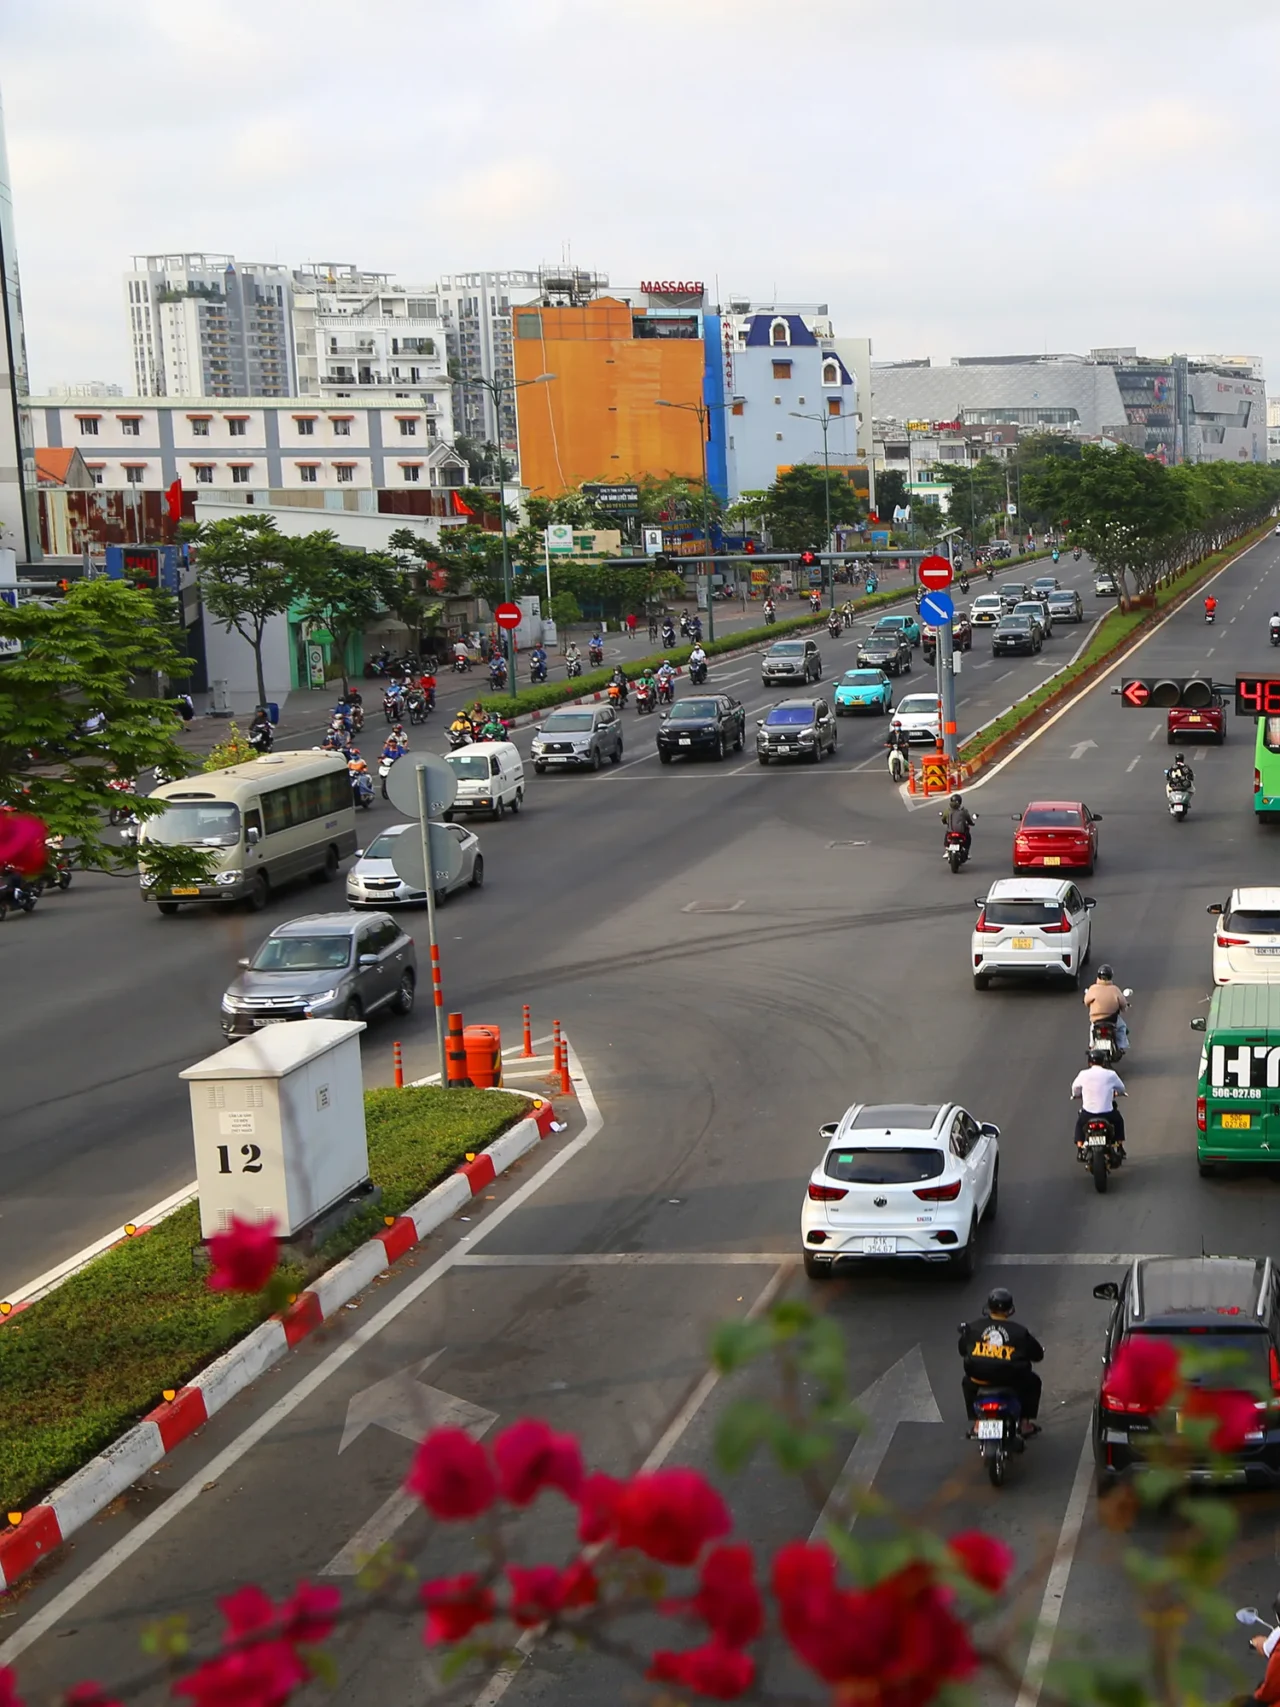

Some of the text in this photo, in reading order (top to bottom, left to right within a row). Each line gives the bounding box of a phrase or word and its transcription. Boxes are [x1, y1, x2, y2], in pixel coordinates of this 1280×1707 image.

[640, 281, 702, 293] MASSAGE
[723, 322, 732, 388] MASSAGE
[1212, 1088, 1262, 1099] 50G-027.68
[217, 1144, 263, 1174] 12
[972, 1341, 1015, 1360] ARMY
